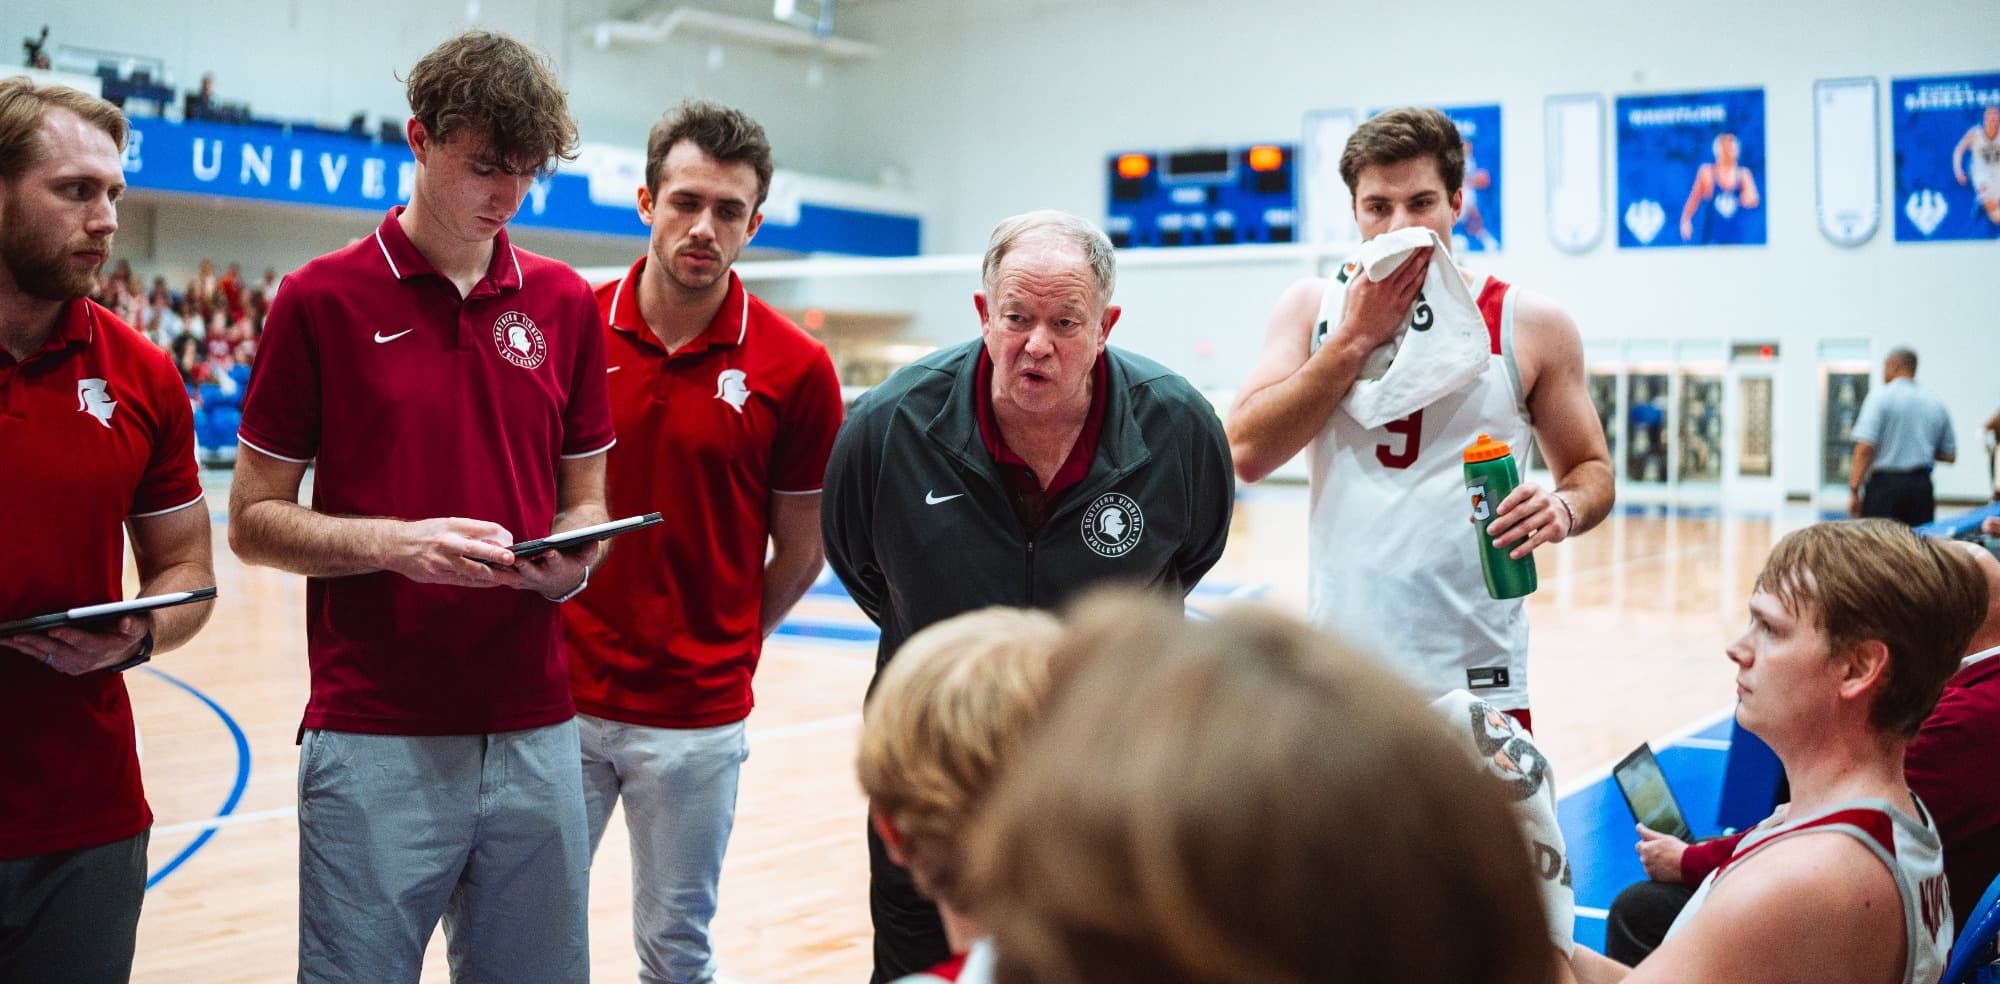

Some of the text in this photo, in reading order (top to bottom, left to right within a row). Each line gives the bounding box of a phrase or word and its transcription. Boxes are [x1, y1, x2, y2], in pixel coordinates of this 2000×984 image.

[1084, 496, 1141, 531] SOUTHERN VIRGINIA
[1088, 535, 1135, 554] VOLLEYBALL
[1497, 673, 1505, 682] L
